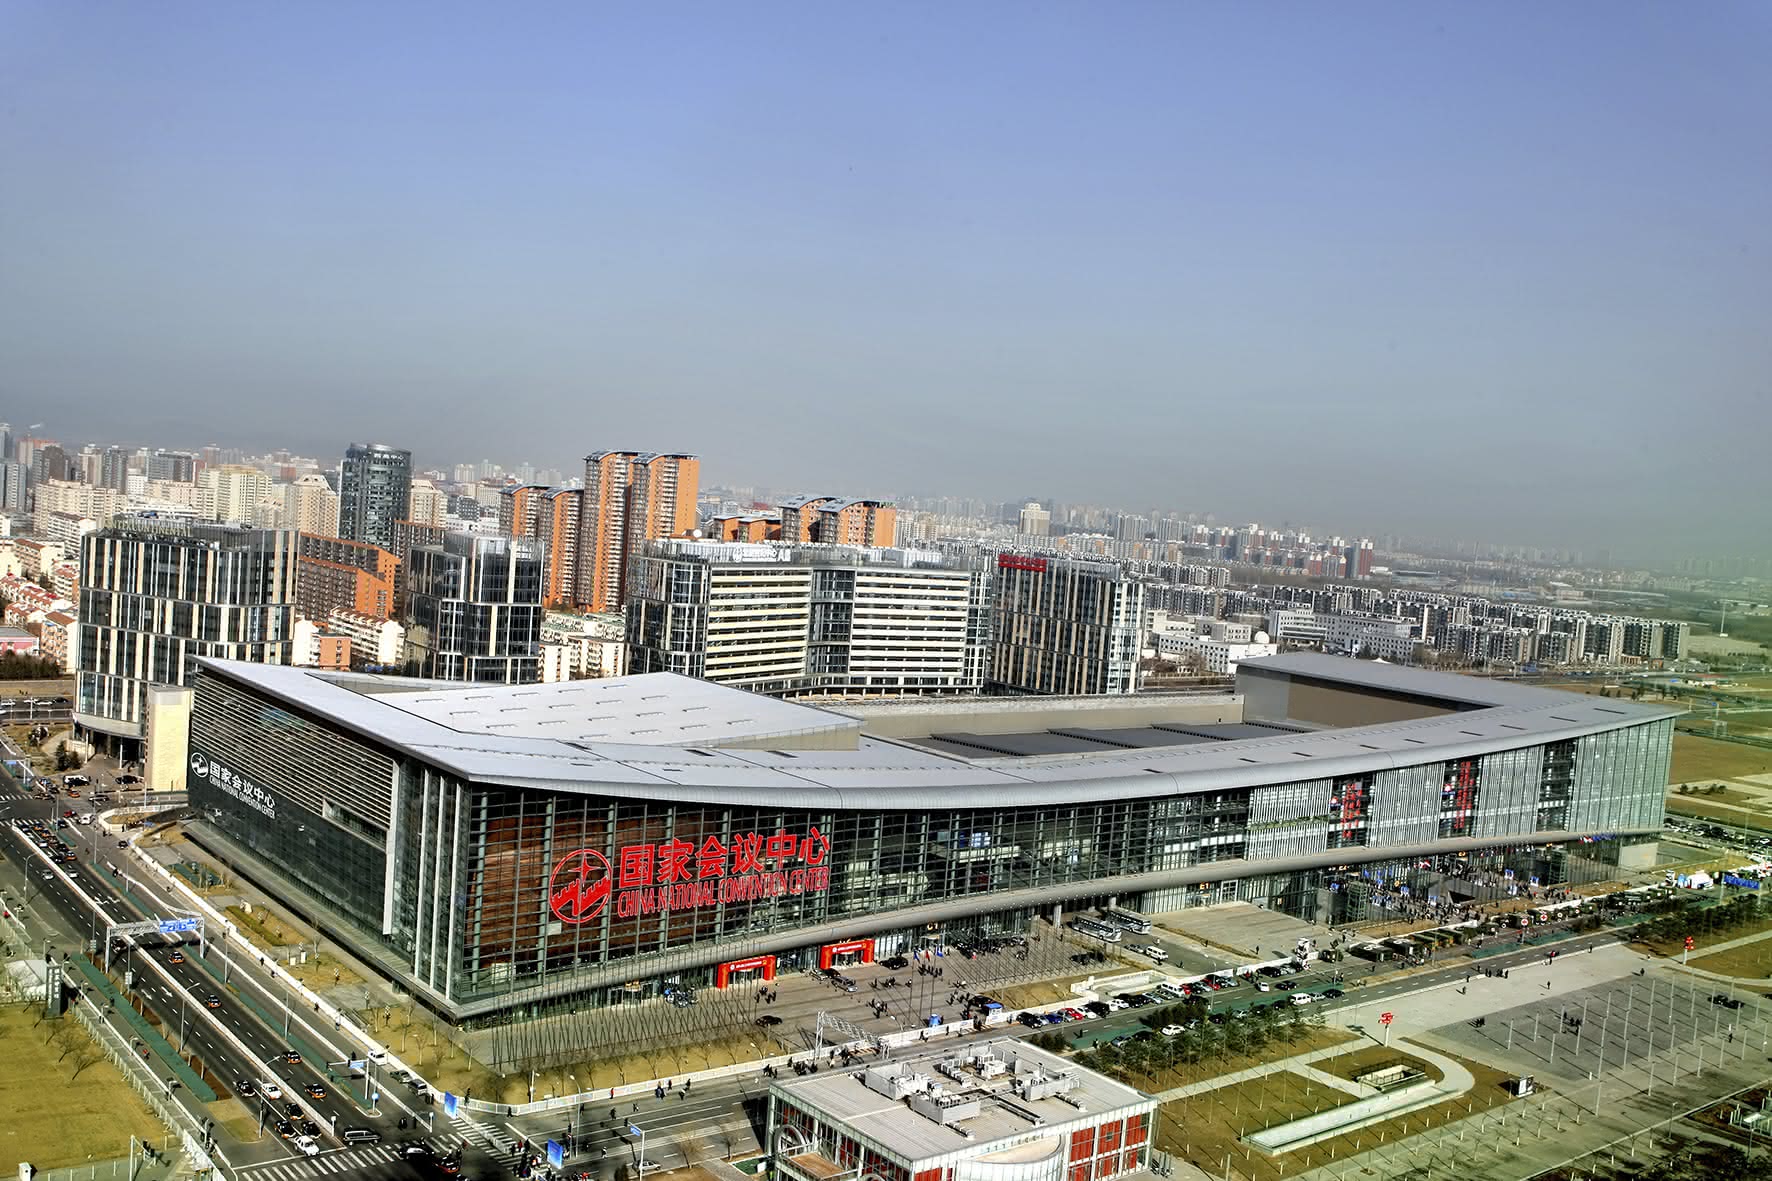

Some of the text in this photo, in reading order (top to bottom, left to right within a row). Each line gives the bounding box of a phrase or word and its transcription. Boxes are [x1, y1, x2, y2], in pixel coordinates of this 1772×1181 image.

[210, 761, 275, 808] 国家会议中心
[618, 827, 830, 888] 国家会议中心
[618, 866, 829, 917] CHINA NATIONAL CONVENTION CENTER
